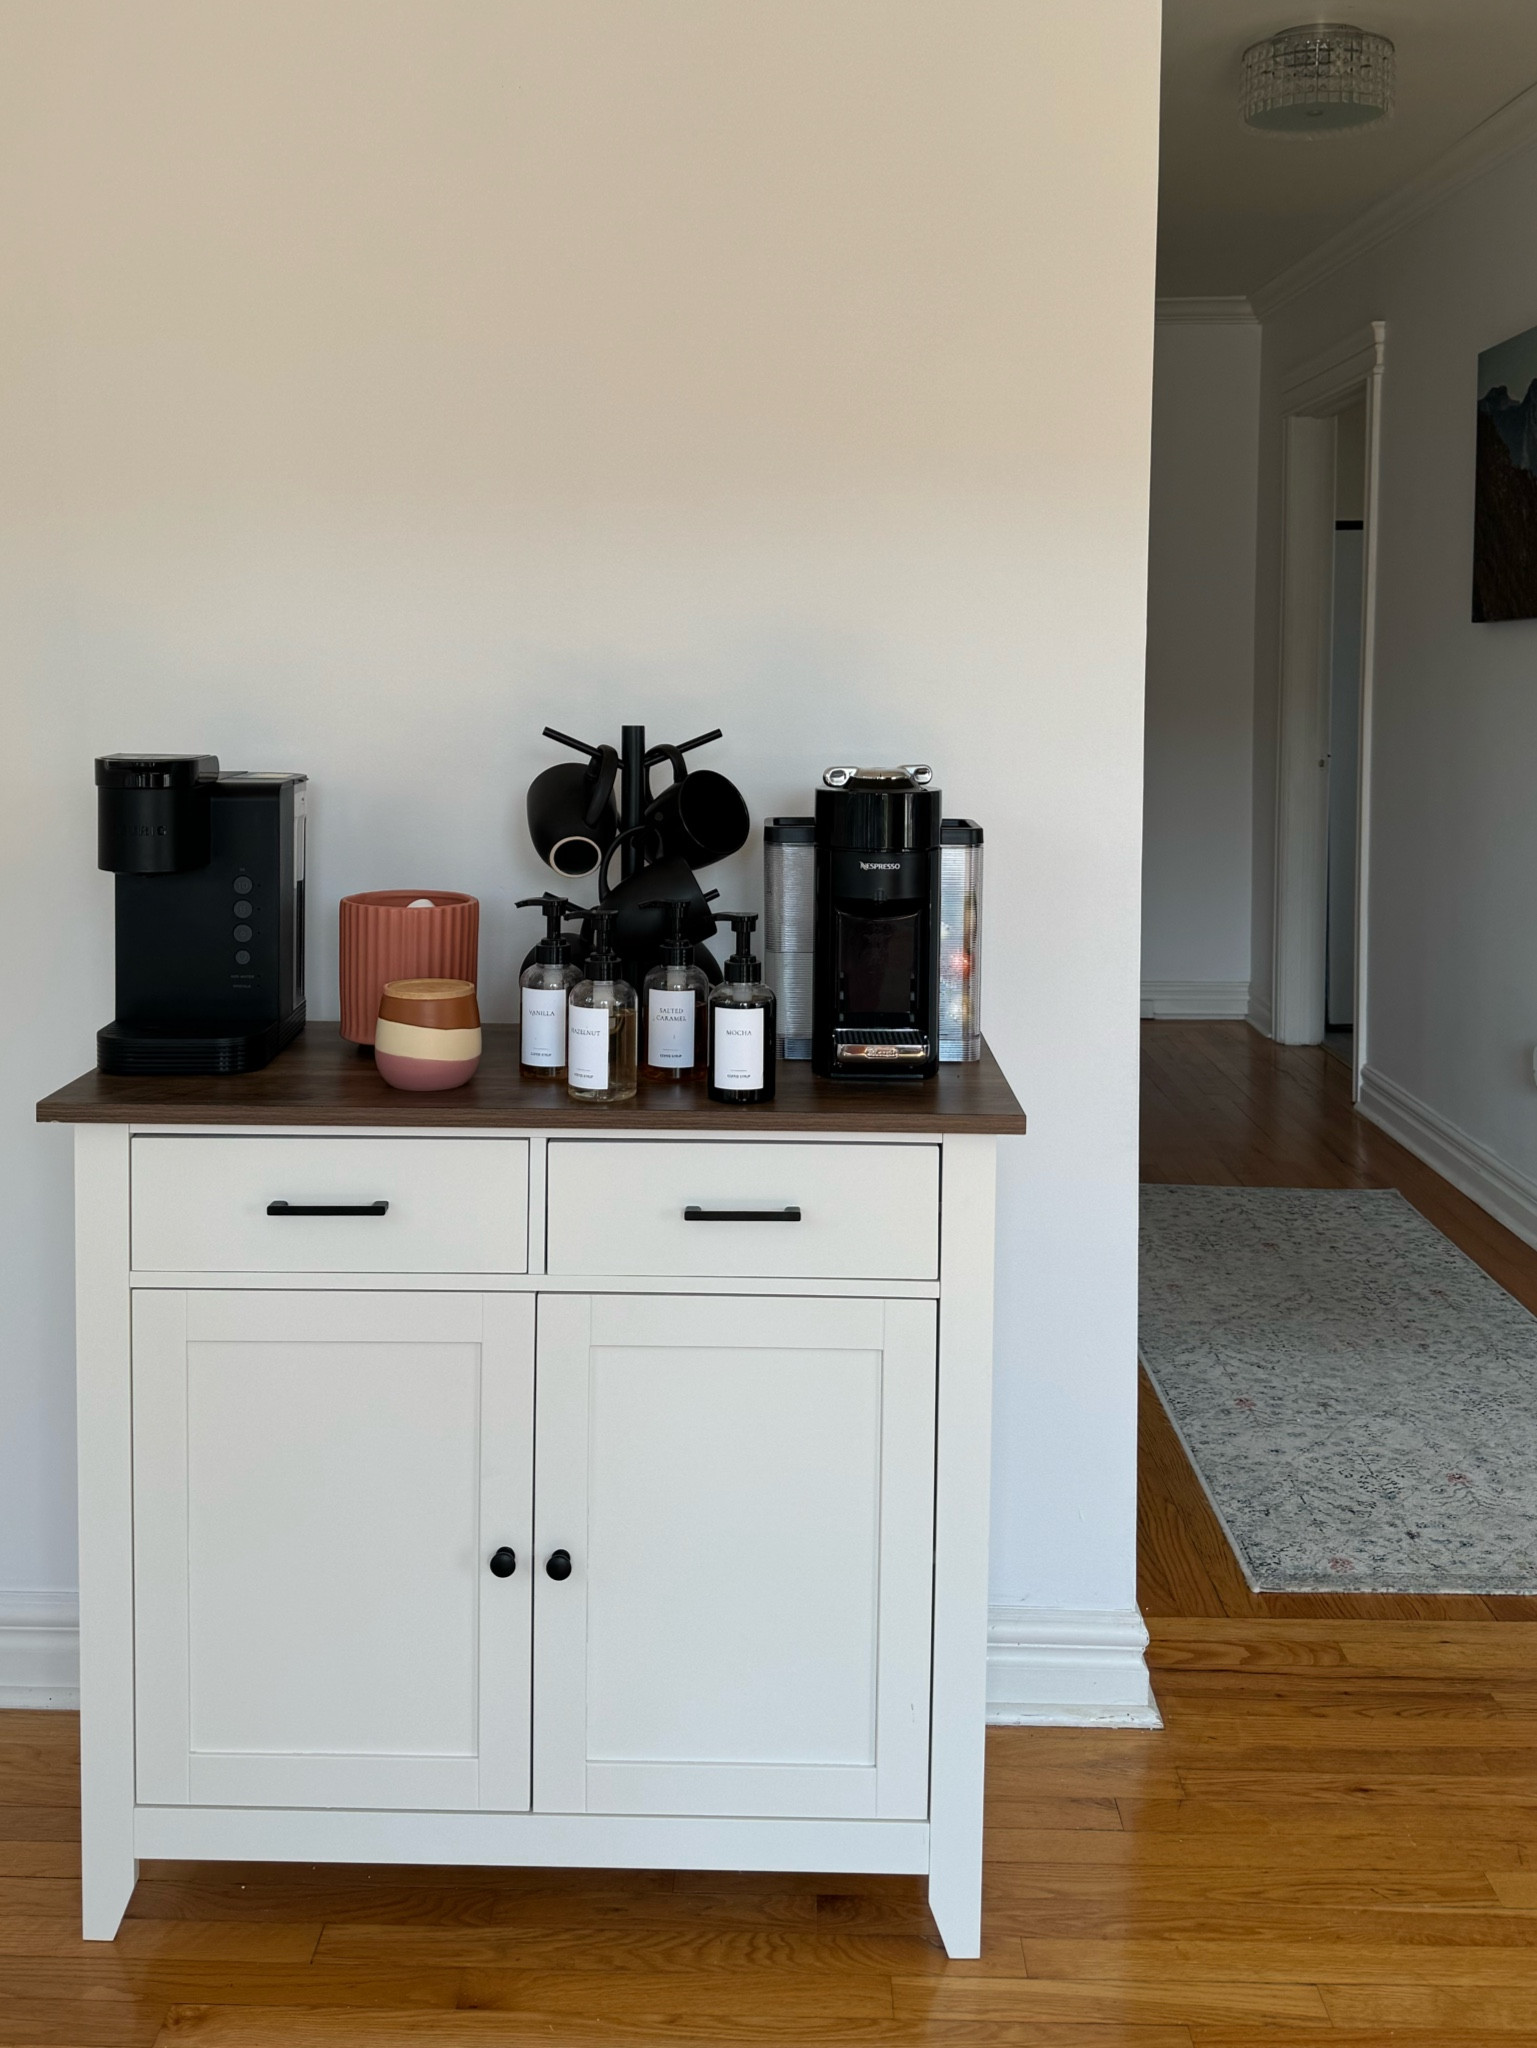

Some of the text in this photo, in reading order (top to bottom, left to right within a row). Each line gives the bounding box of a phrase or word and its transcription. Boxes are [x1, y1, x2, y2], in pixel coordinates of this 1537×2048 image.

[859, 861, 901, 871] NESPRESSO
[529, 1009, 556, 1018] VANILLA
[570, 1027, 601, 1037] HAZELNUT
